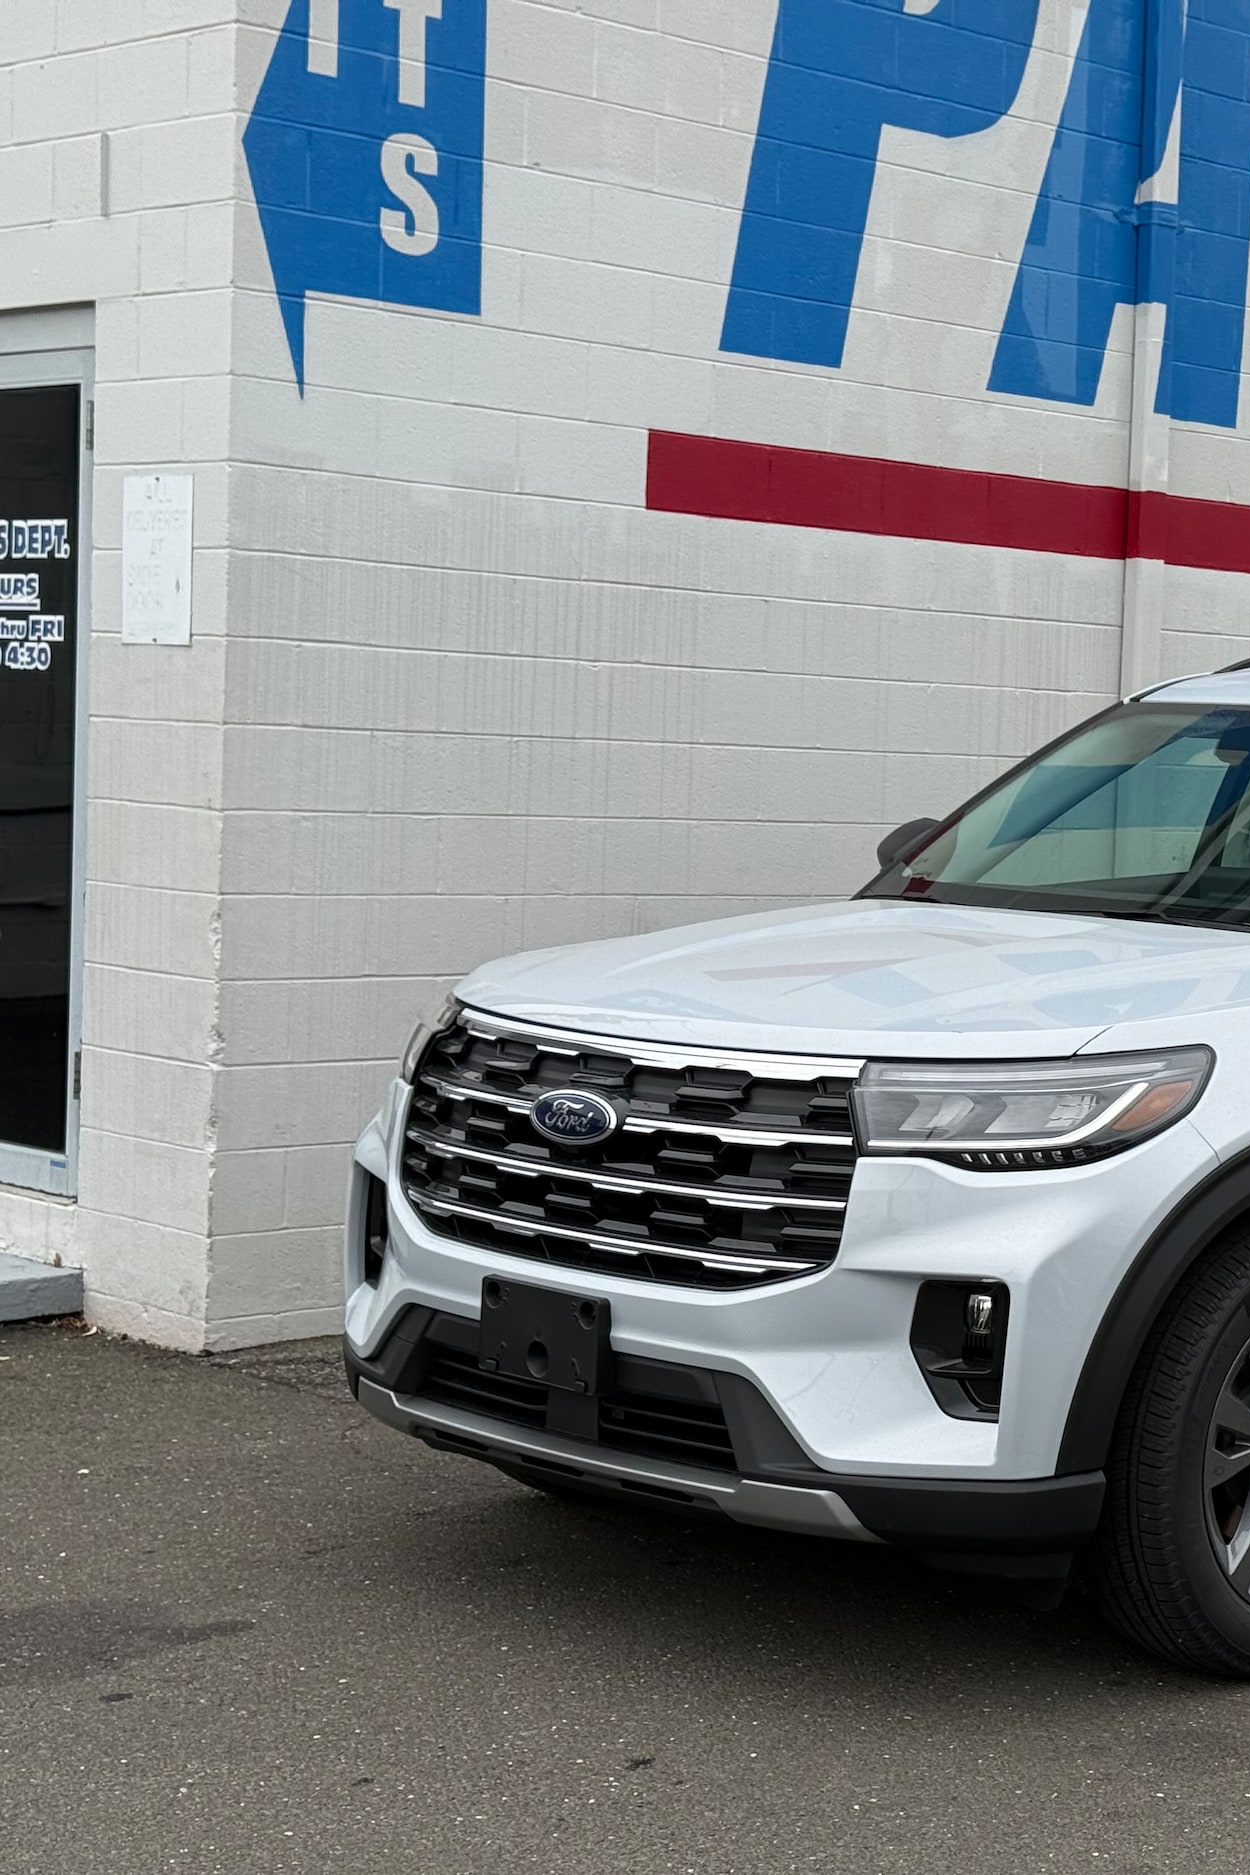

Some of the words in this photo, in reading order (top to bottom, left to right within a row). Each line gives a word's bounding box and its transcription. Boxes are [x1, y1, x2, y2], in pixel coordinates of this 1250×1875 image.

[12, 520, 70, 558] DEPT.
[29, 616, 64, 640] FRI
[6, 643, 50, 669] 4:30
[545, 1099, 594, 1133] Ford
